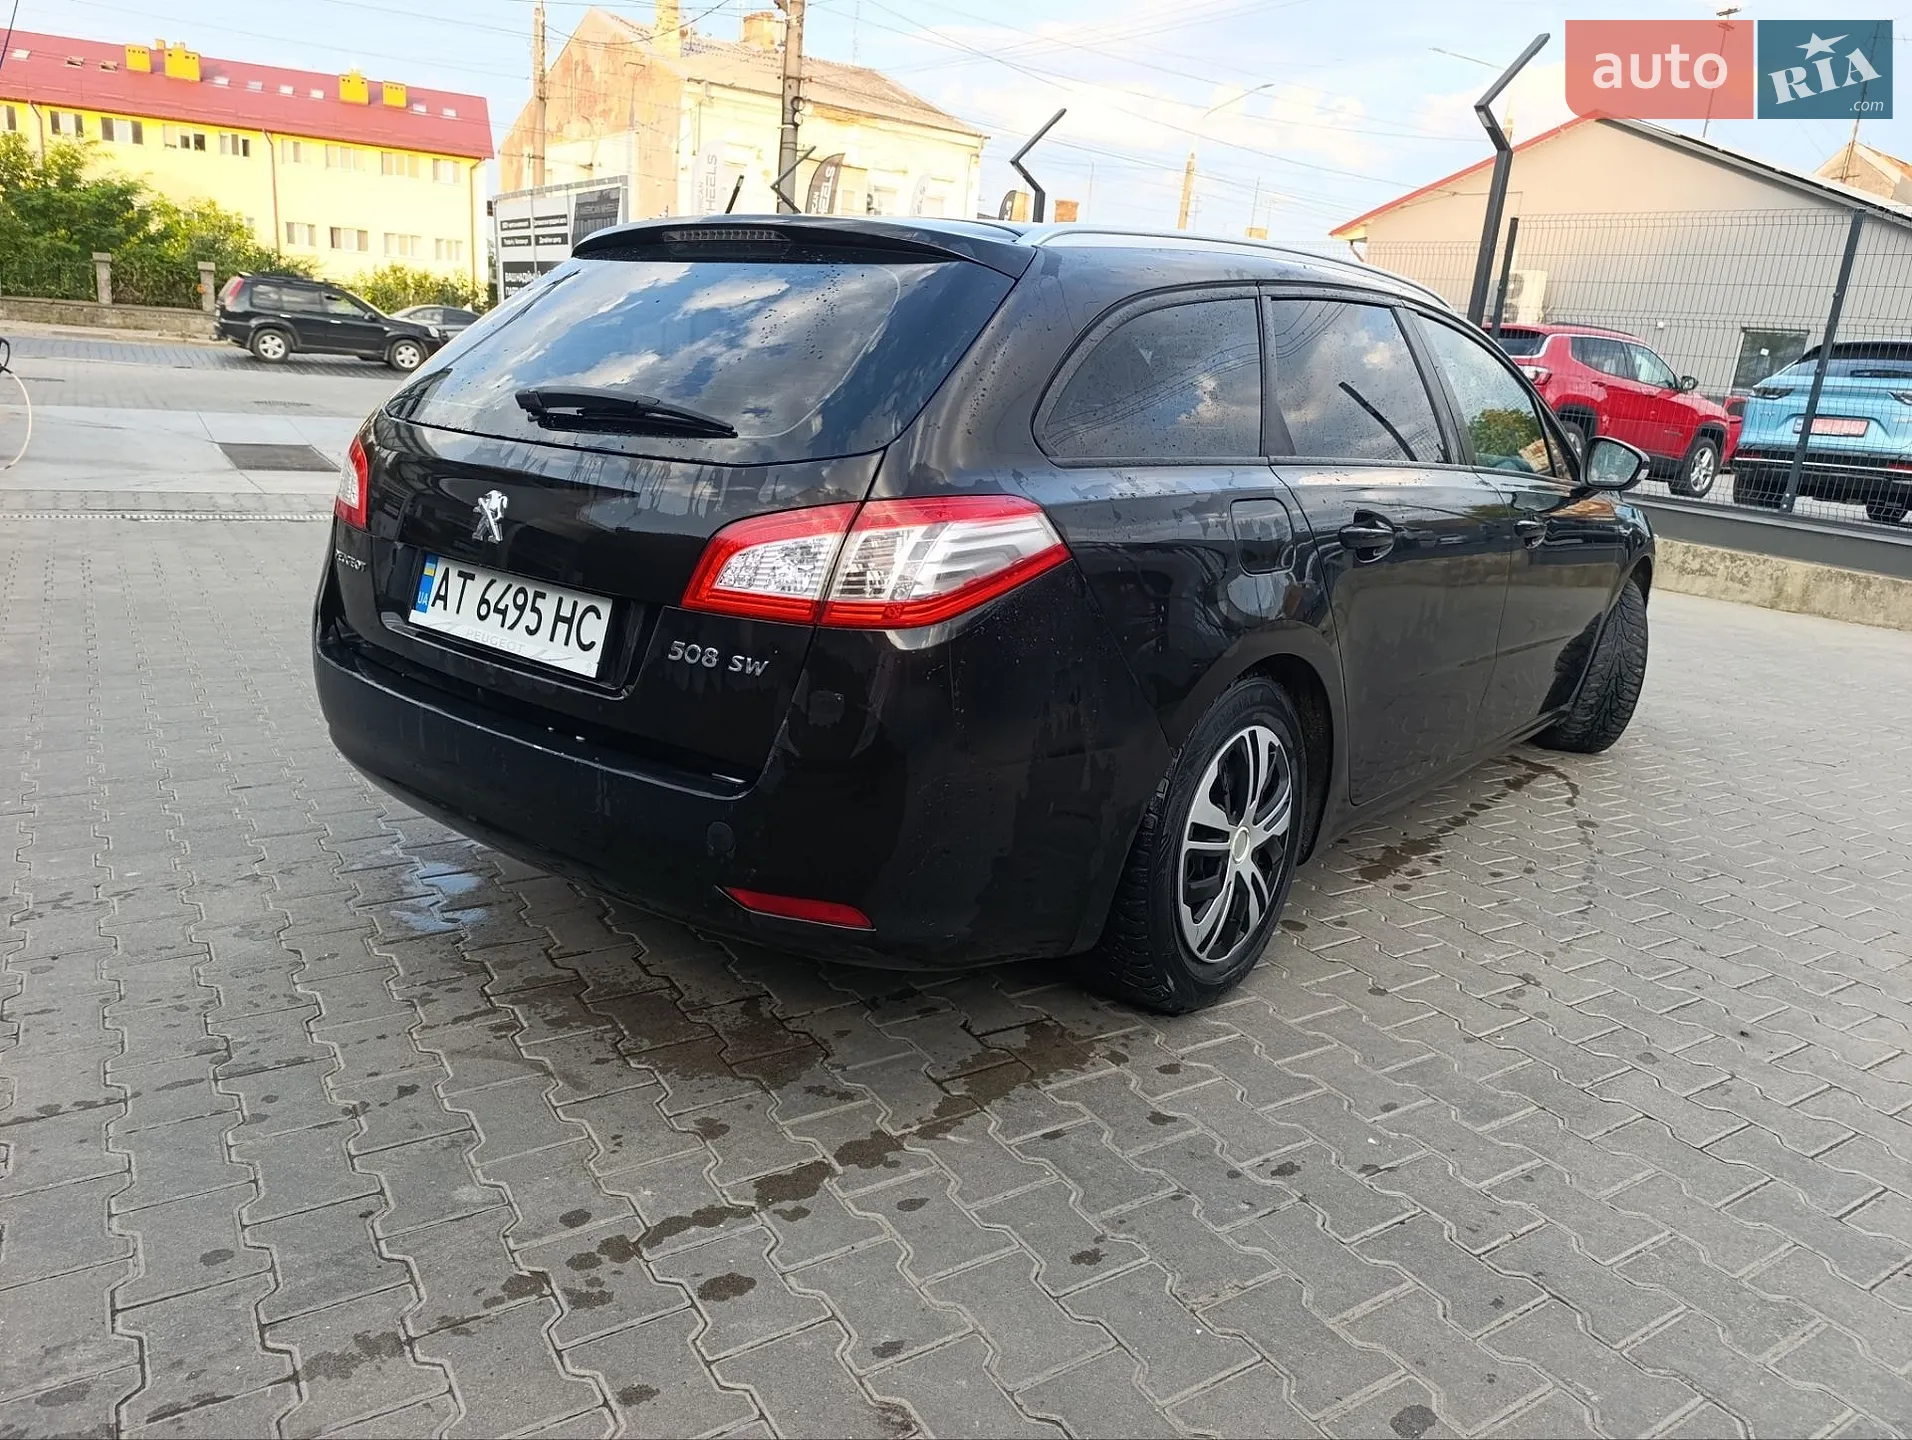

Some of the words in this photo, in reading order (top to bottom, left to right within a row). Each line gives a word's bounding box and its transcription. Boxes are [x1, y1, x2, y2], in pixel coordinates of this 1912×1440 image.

[705, 153, 718, 213] HEELS
[418, 591, 428, 606] UA
[431, 567, 476, 614] AT
[476, 578, 547, 636] 6495
[549, 596, 602, 652] HC
[464, 627, 527, 652] PEUGEOT
[667, 640, 719, 668] 508
[728, 655, 769, 676] SW
